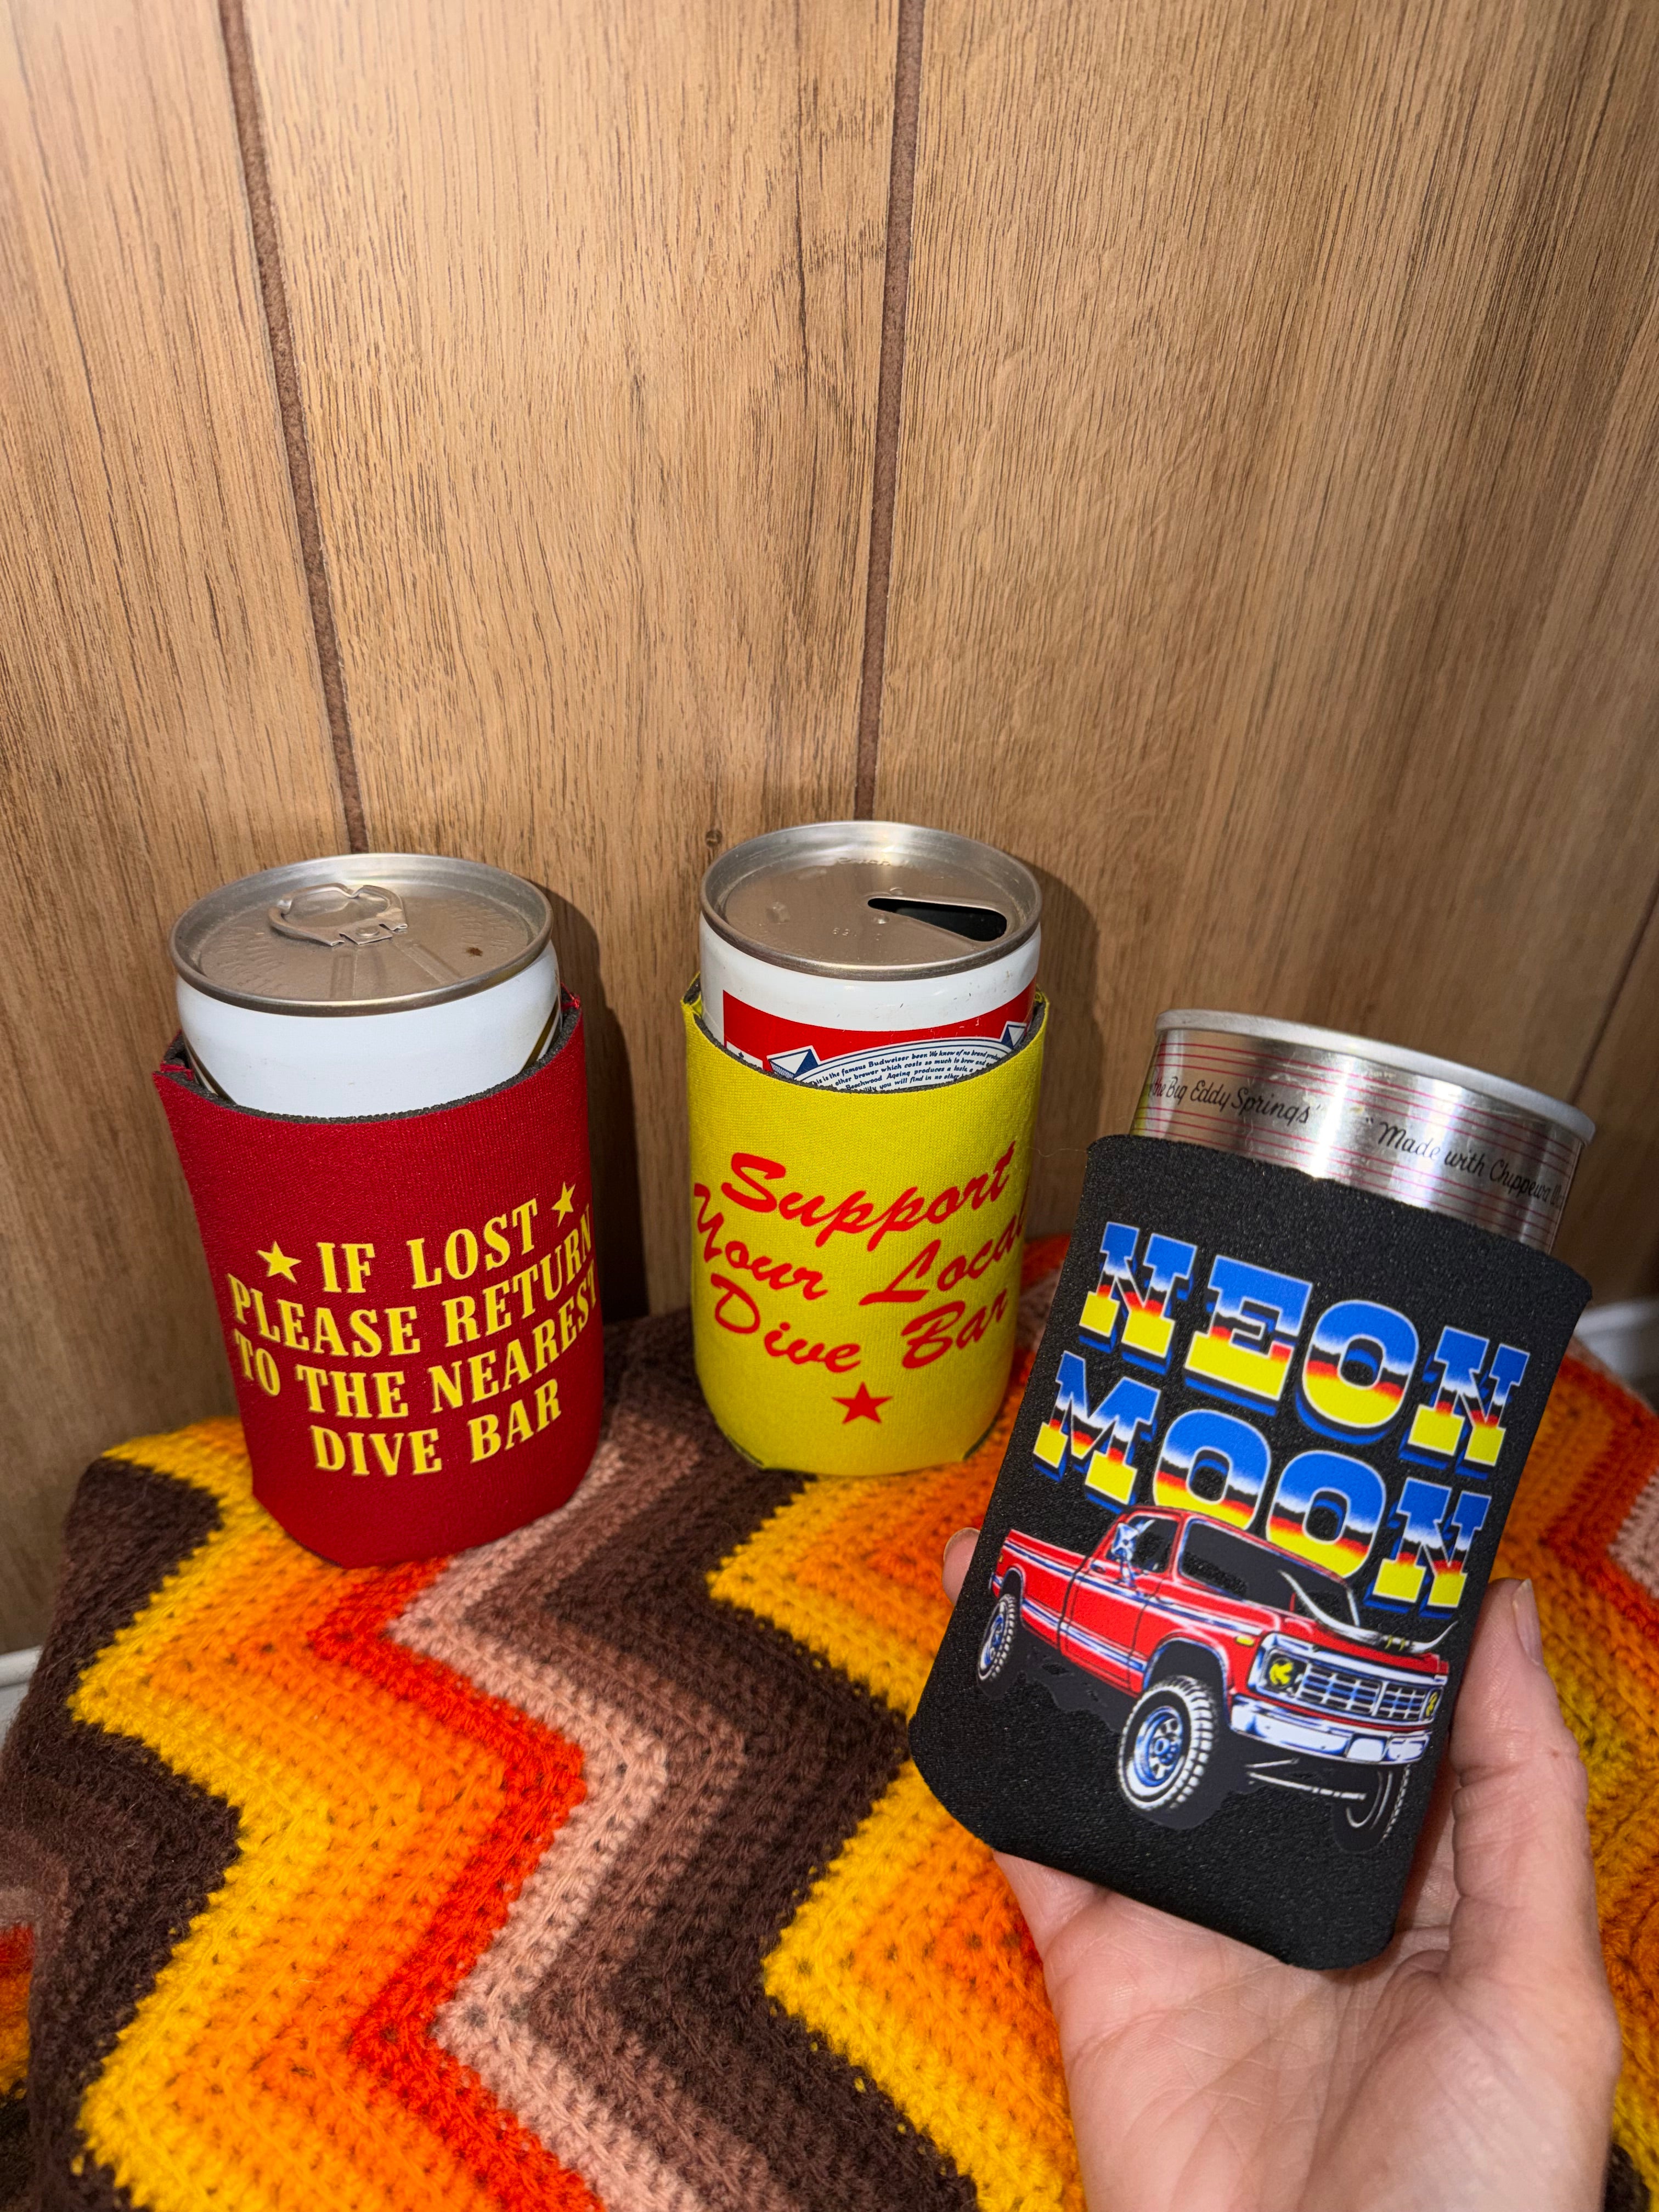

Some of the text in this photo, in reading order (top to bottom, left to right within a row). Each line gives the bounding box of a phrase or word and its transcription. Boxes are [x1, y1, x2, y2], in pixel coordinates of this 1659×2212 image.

[829, 1071, 840, 1080] the
[841, 1064, 866, 1077] famous
[868, 1056, 909, 1068] Budweiser
[835, 1077, 851, 1086] other
[853, 1069, 879, 1080] brewer
[881, 1063, 902, 1073] which
[904, 1060, 922, 1069] costs
[845, 1075, 883, 1091] Beechwood
[886, 1070, 911, 1080] Ageing
[913, 1067, 945, 1076] produces
[894, 1077, 908, 1086] will
[910, 1075, 923, 1084] find
[1166, 1076, 1188, 1105] Big
[1189, 1080, 1231, 1112] Eddy
[721, 1140, 1016, 1252] Support
[1443, 1148, 1486, 1177] with
[1489, 1159, 1551, 1203] Chippewa
[226, 1203, 592, 1358] PLEASE RETURN
[317, 1198, 538, 1294] IF LOST
[694, 1176, 1030, 1306] Your Local
[234, 1259, 597, 1419] TO THE NEAREST
[711, 1273, 1008, 1373] Dive Bar
[1078, 1221, 1530, 1480] NEON
[310, 1378, 562, 1476] DIVE BAR
[1032, 1350, 1492, 1619] MOON
